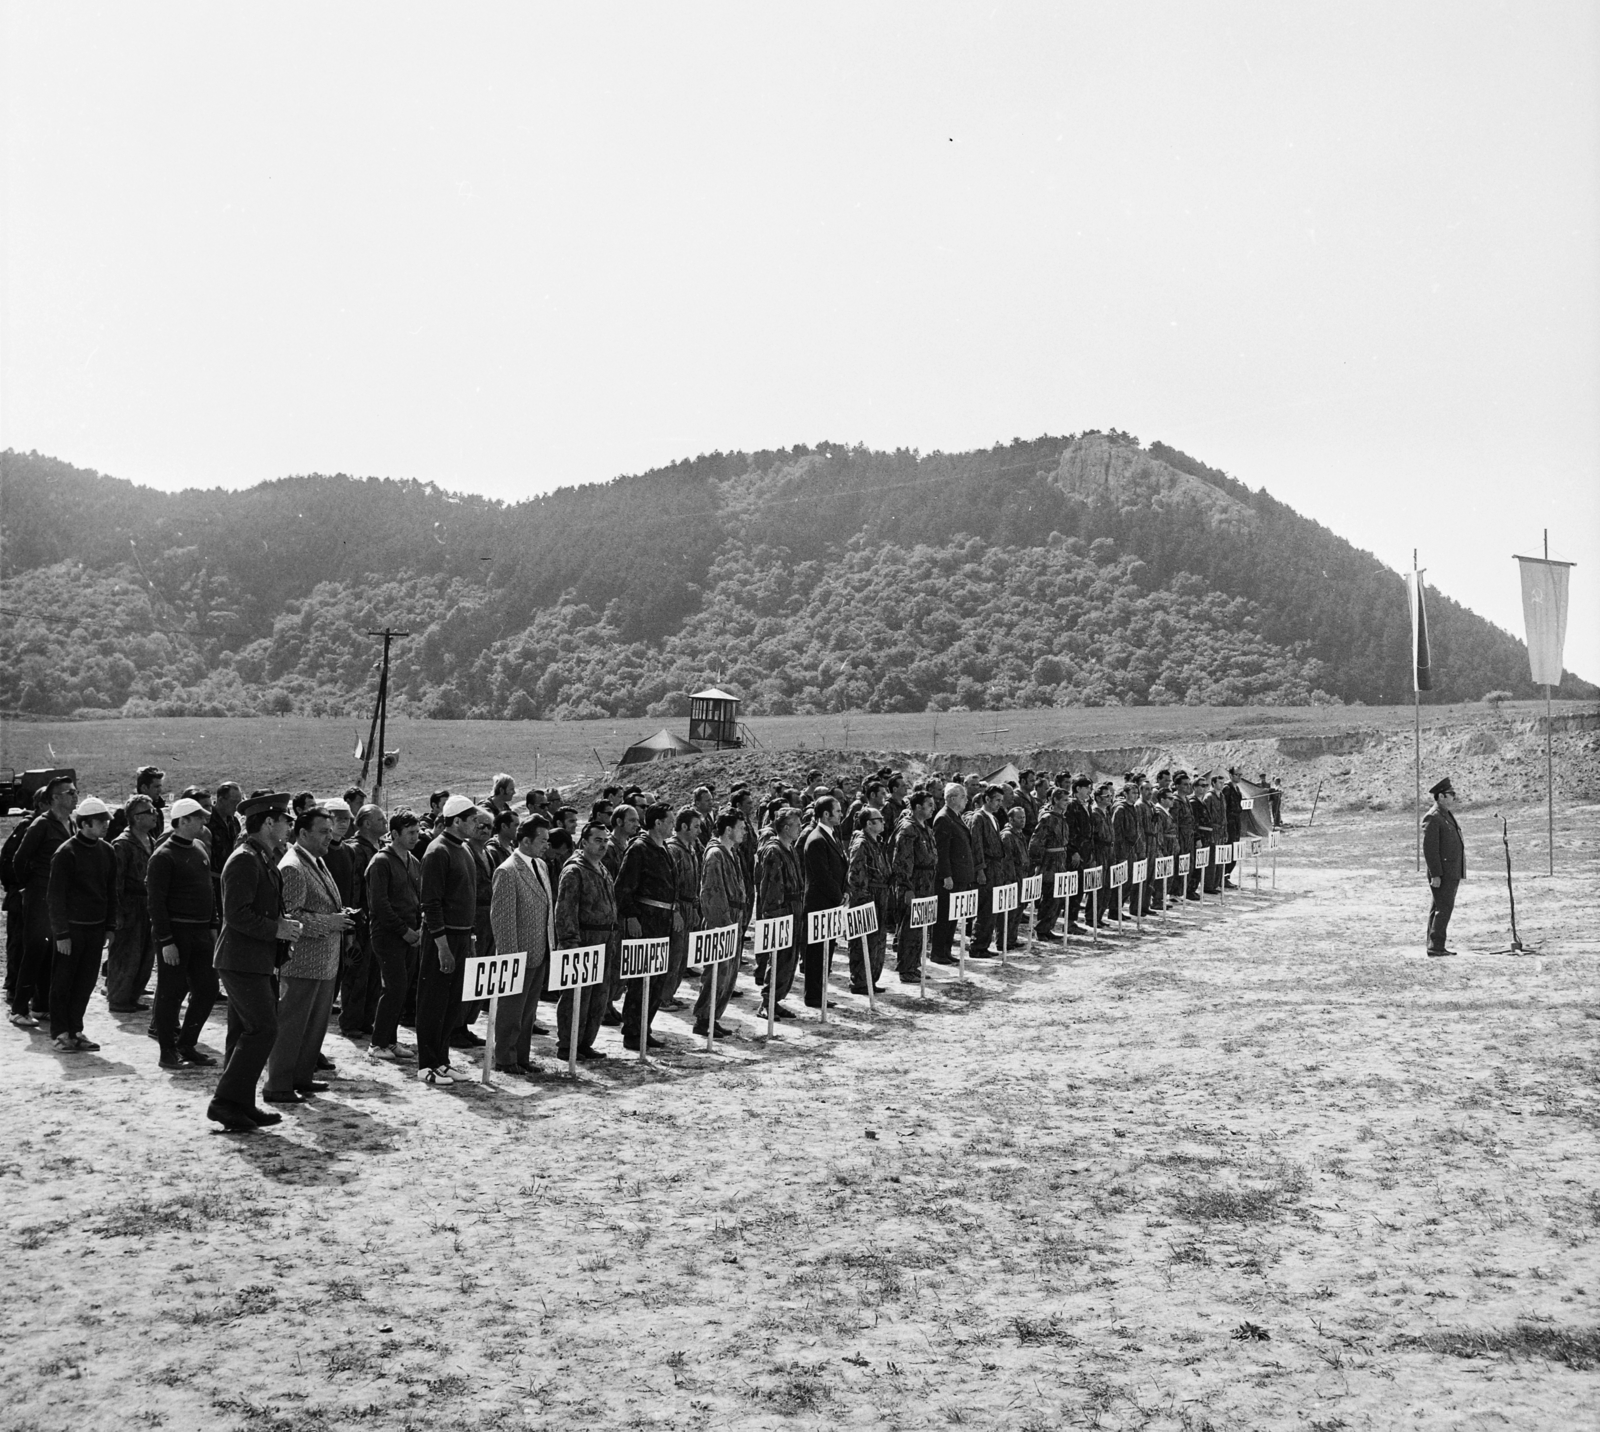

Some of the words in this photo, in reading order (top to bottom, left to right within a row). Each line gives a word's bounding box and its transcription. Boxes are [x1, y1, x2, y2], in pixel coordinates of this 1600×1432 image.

[621, 941, 669, 976] BUDAPEST
[694, 929, 737, 964] BORSOD
[560, 950, 599, 987] CSSR
